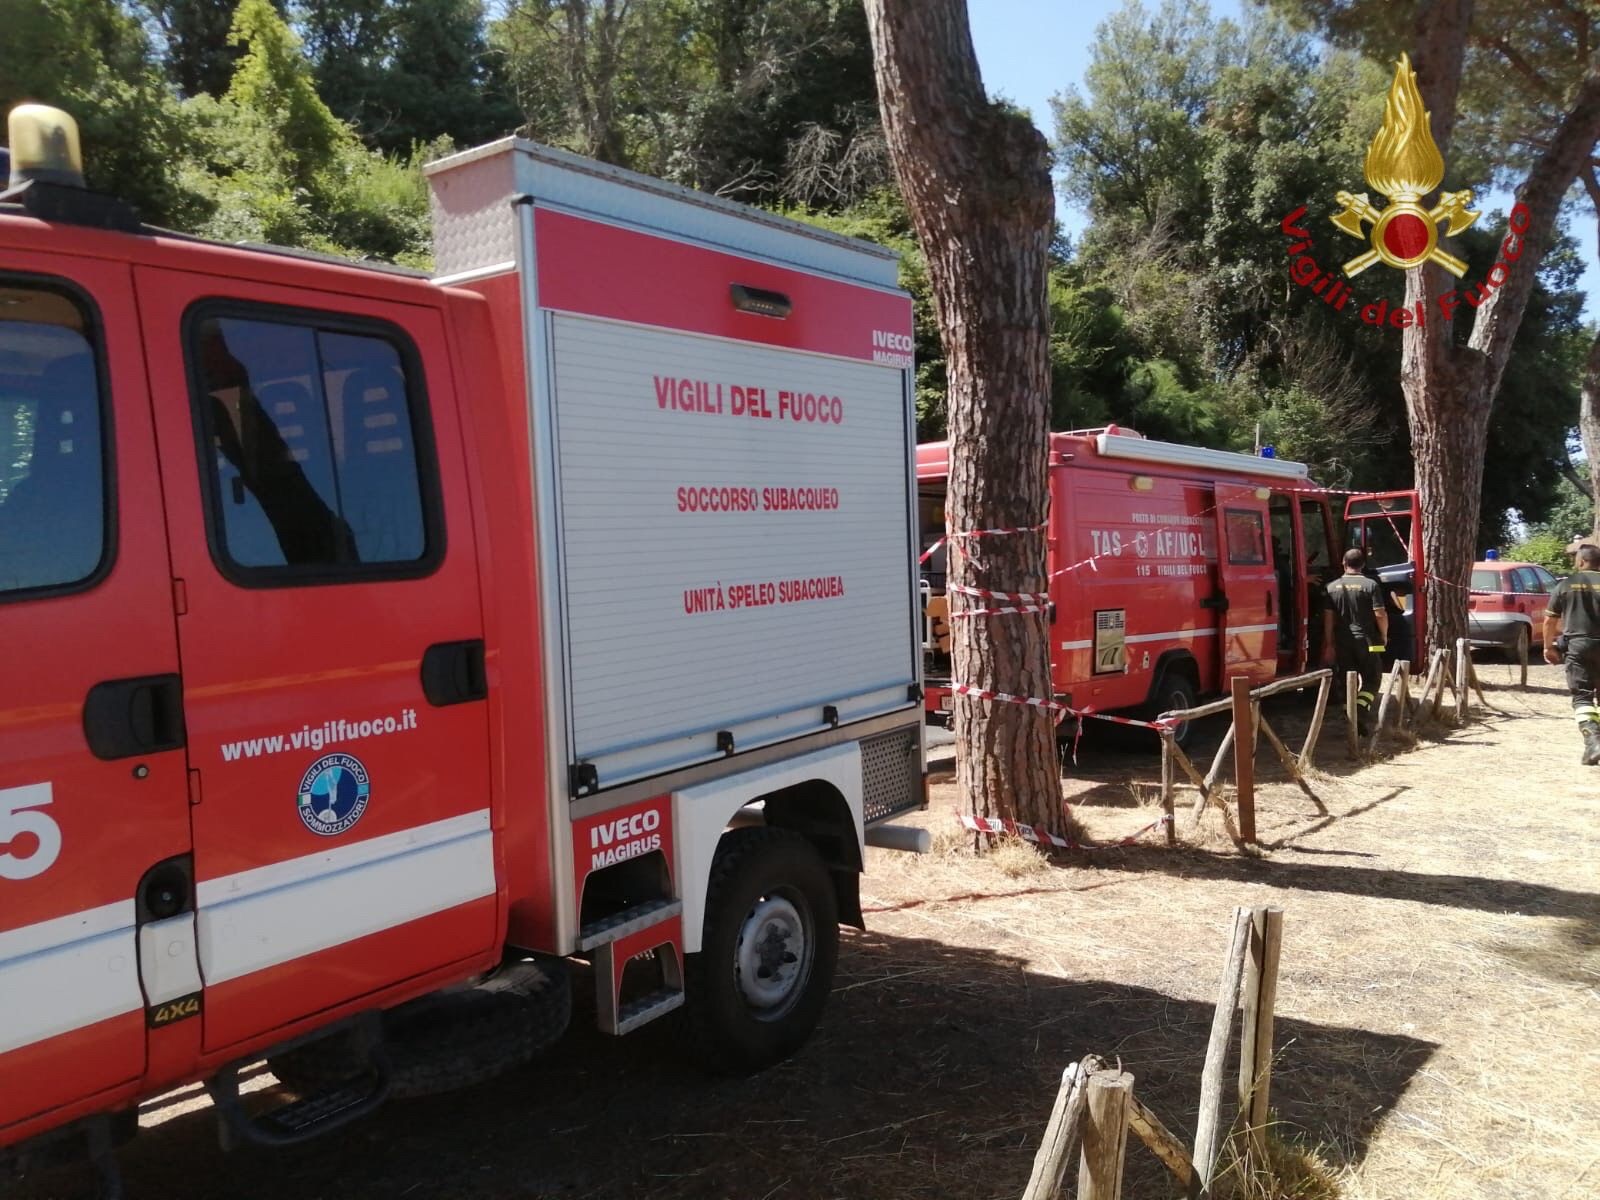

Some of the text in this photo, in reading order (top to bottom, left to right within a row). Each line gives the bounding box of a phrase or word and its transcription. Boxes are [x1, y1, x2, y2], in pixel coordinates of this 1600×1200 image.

[873, 329, 912, 352] IVECO
[873, 350, 912, 368] MAGIRUS
[653, 375, 842, 424] VIGILI DEL FUOCO
[677, 487, 839, 512] SOCCORSO SUBACQUEO
[1091, 530, 1205, 558] TAS AF/UCL
[1136, 564, 1150, 576] 115
[684, 576, 844, 614] UNITÀ SPELEO SUBACQUEA
[221, 708, 417, 761] www.vigilfuoco.it
[303, 757, 365, 791] VIGILI DEL FUOCO
[0, 781, 62, 880] 5
[303, 800, 365, 832] SOMMOZZATORI
[591, 809, 660, 849] IVECO
[592, 834, 661, 871] MAGIRUS
